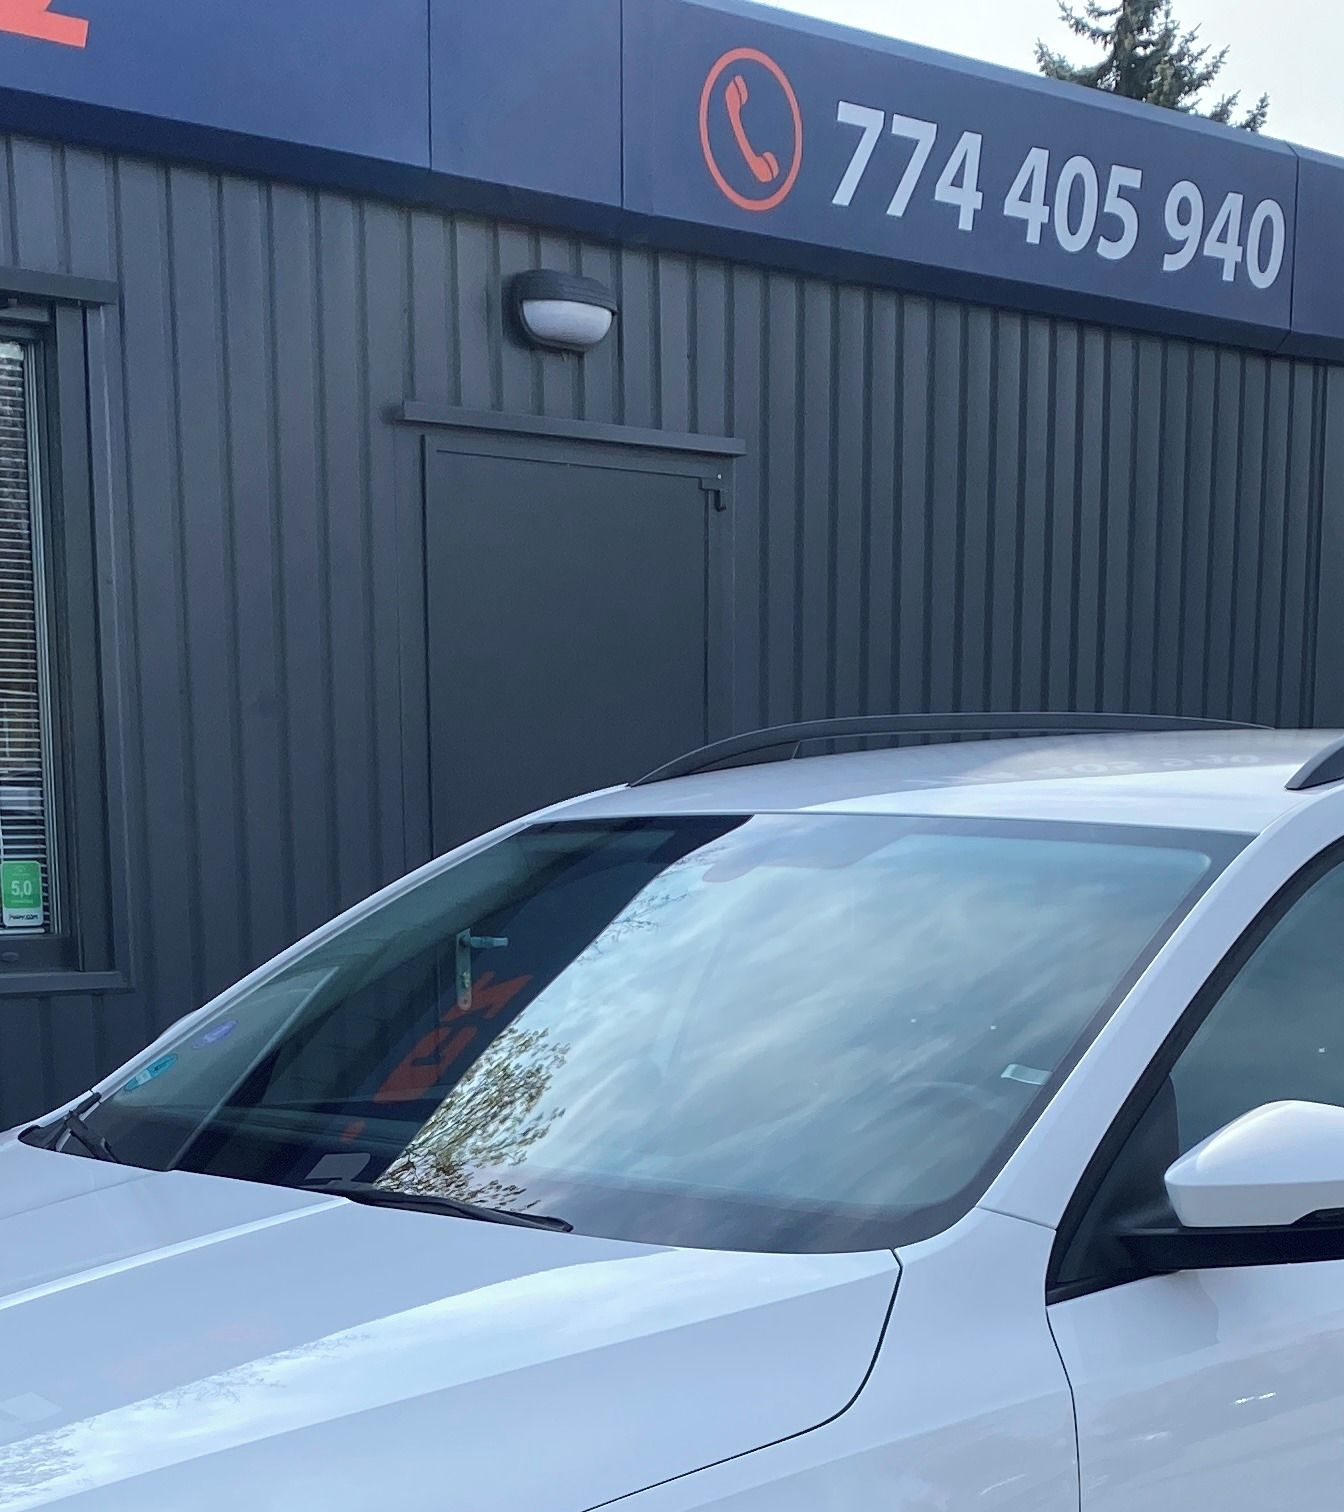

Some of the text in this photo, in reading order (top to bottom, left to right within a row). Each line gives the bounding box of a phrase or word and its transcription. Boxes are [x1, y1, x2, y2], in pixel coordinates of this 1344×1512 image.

[831, 100, 1286, 289] 774 405 940
[11, 880, 32, 898] 5,0
